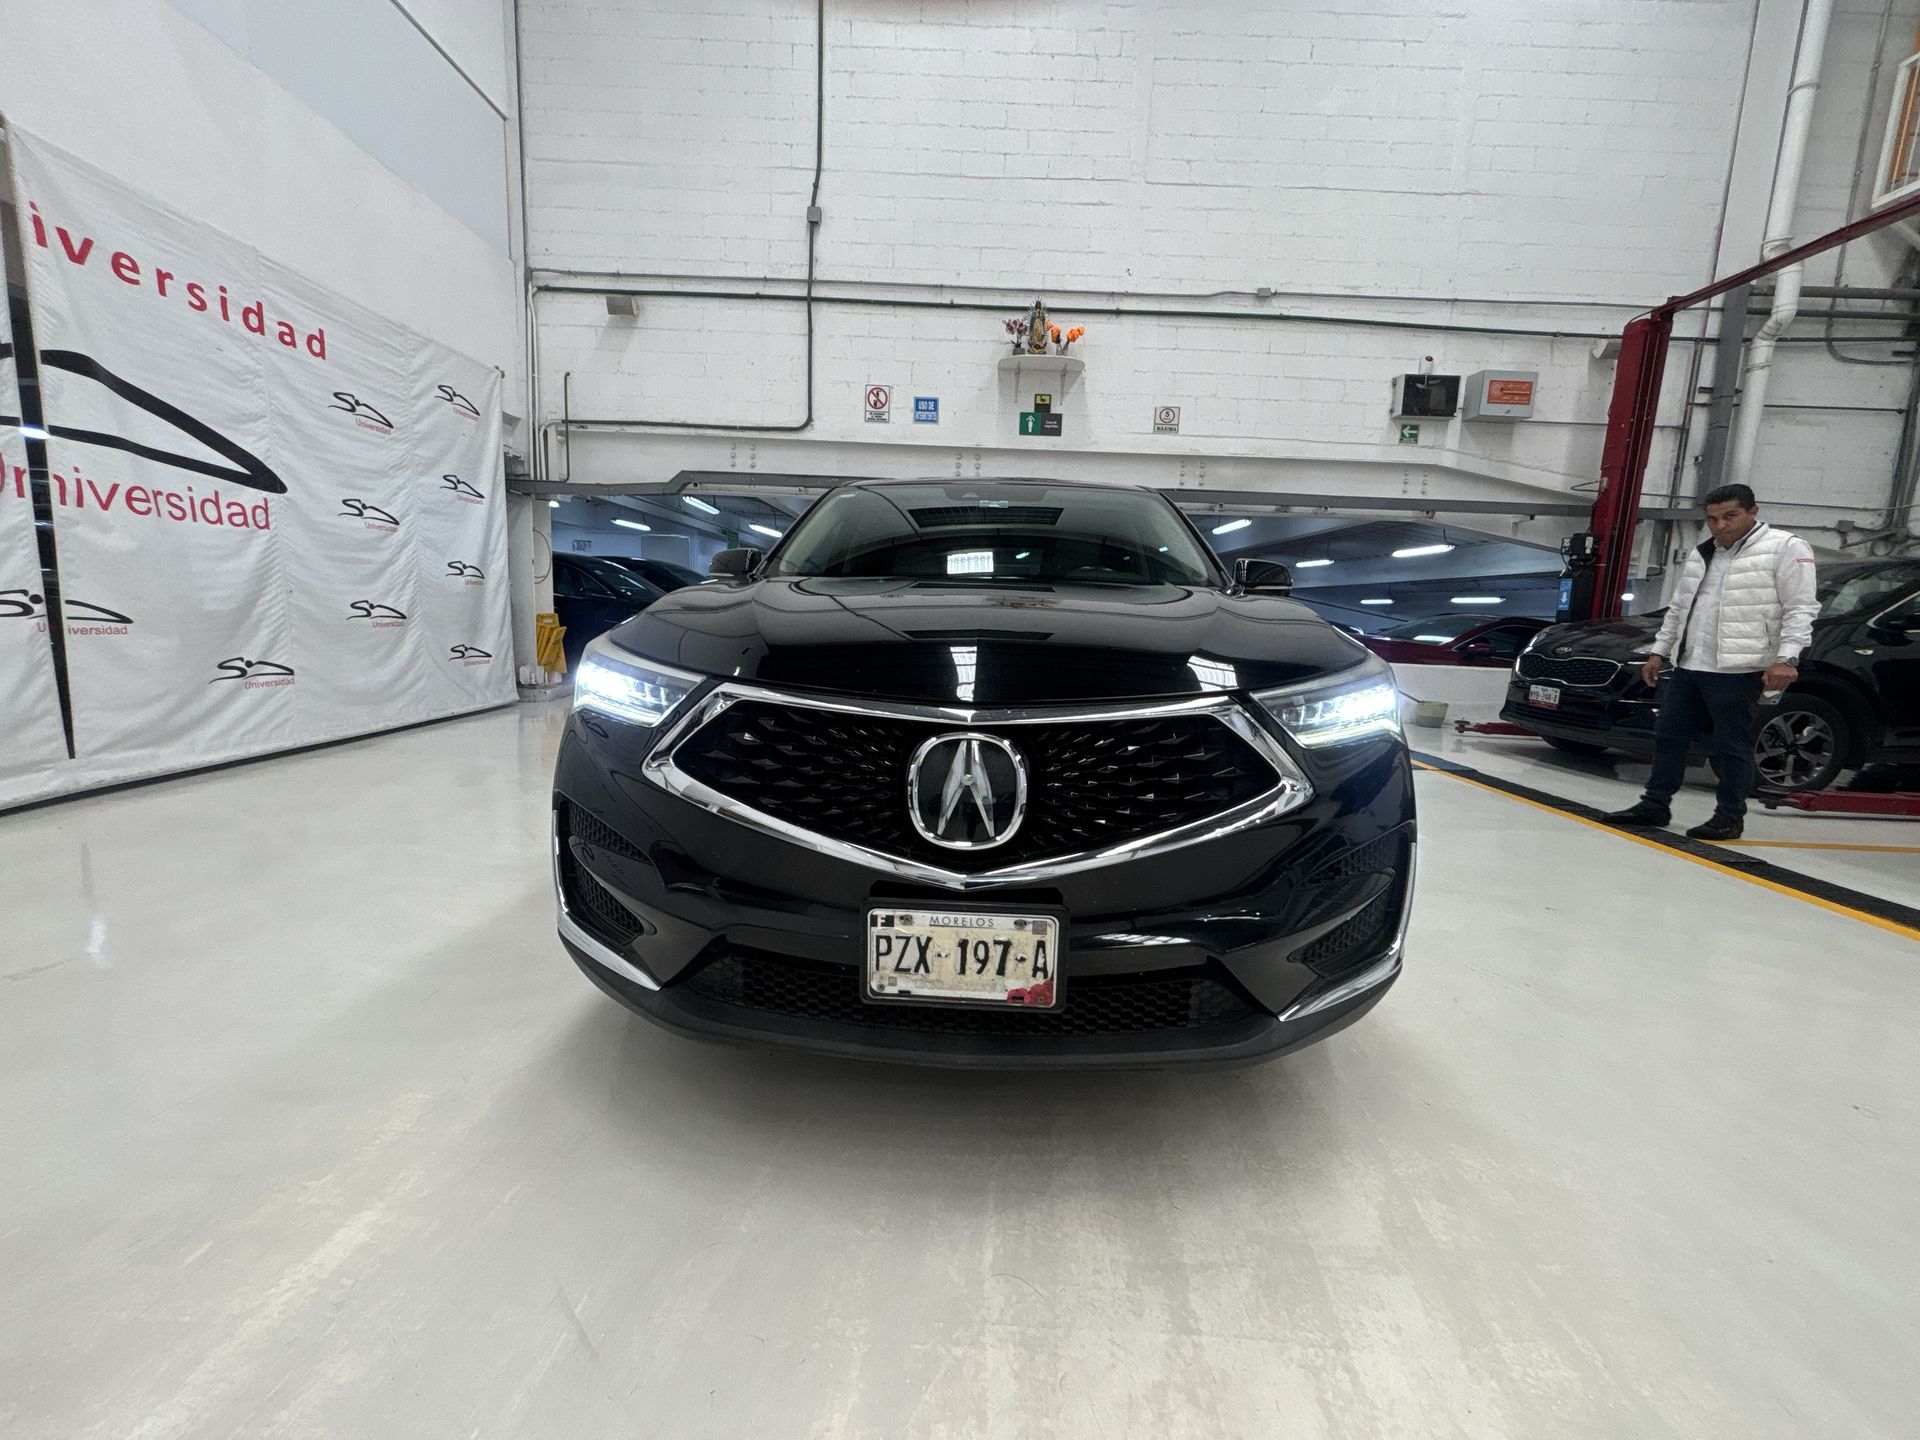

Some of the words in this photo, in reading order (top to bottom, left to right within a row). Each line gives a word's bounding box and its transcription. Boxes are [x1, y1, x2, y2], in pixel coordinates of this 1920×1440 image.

[355, 417, 392, 436] Universidad
[0, 450, 271, 530] niversidad
[36, 622, 128, 635] Uiversidad
[244, 676, 296, 690] Universidad
[929, 915, 995, 927] MORELOS
